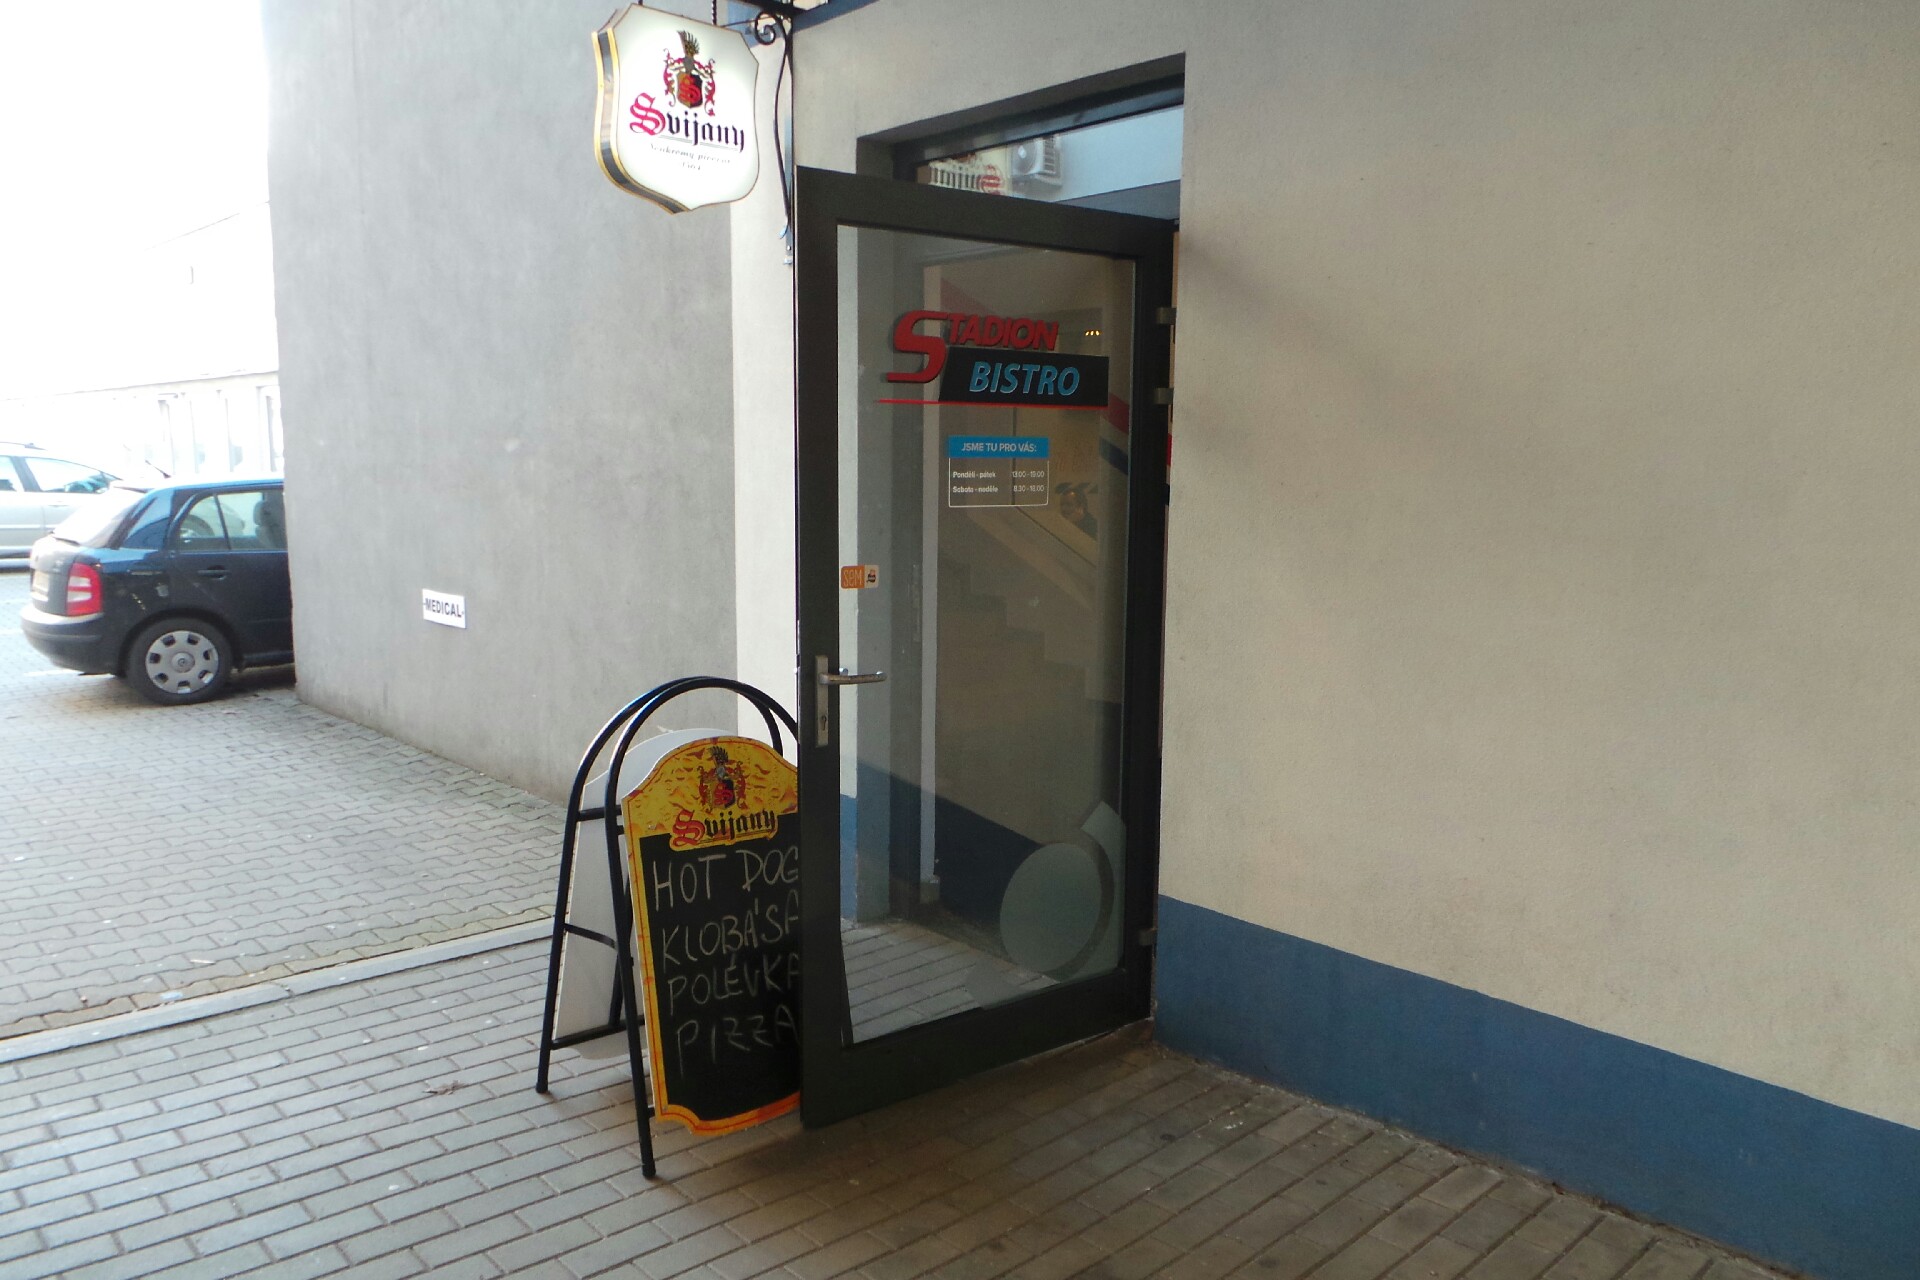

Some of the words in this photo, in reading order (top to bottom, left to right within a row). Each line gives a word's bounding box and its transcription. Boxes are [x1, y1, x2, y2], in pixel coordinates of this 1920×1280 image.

[629, 92, 745, 153] Svijany
[887, 309, 1059, 384] STADION
[969, 361, 1081, 397] BISTRO
[961, 442, 984, 452] JSME
[985, 442, 998, 452] TU
[999, 443, 1017, 452] PRO
[1018, 440, 1037, 452] VÁS:
[425, 597, 462, 618] MEDICAL
[672, 808, 777, 848] Svijany
[652, 853, 726, 911] HOT
[735, 845, 799, 892] DOG
[676, 1004, 799, 1080] PIZZA
